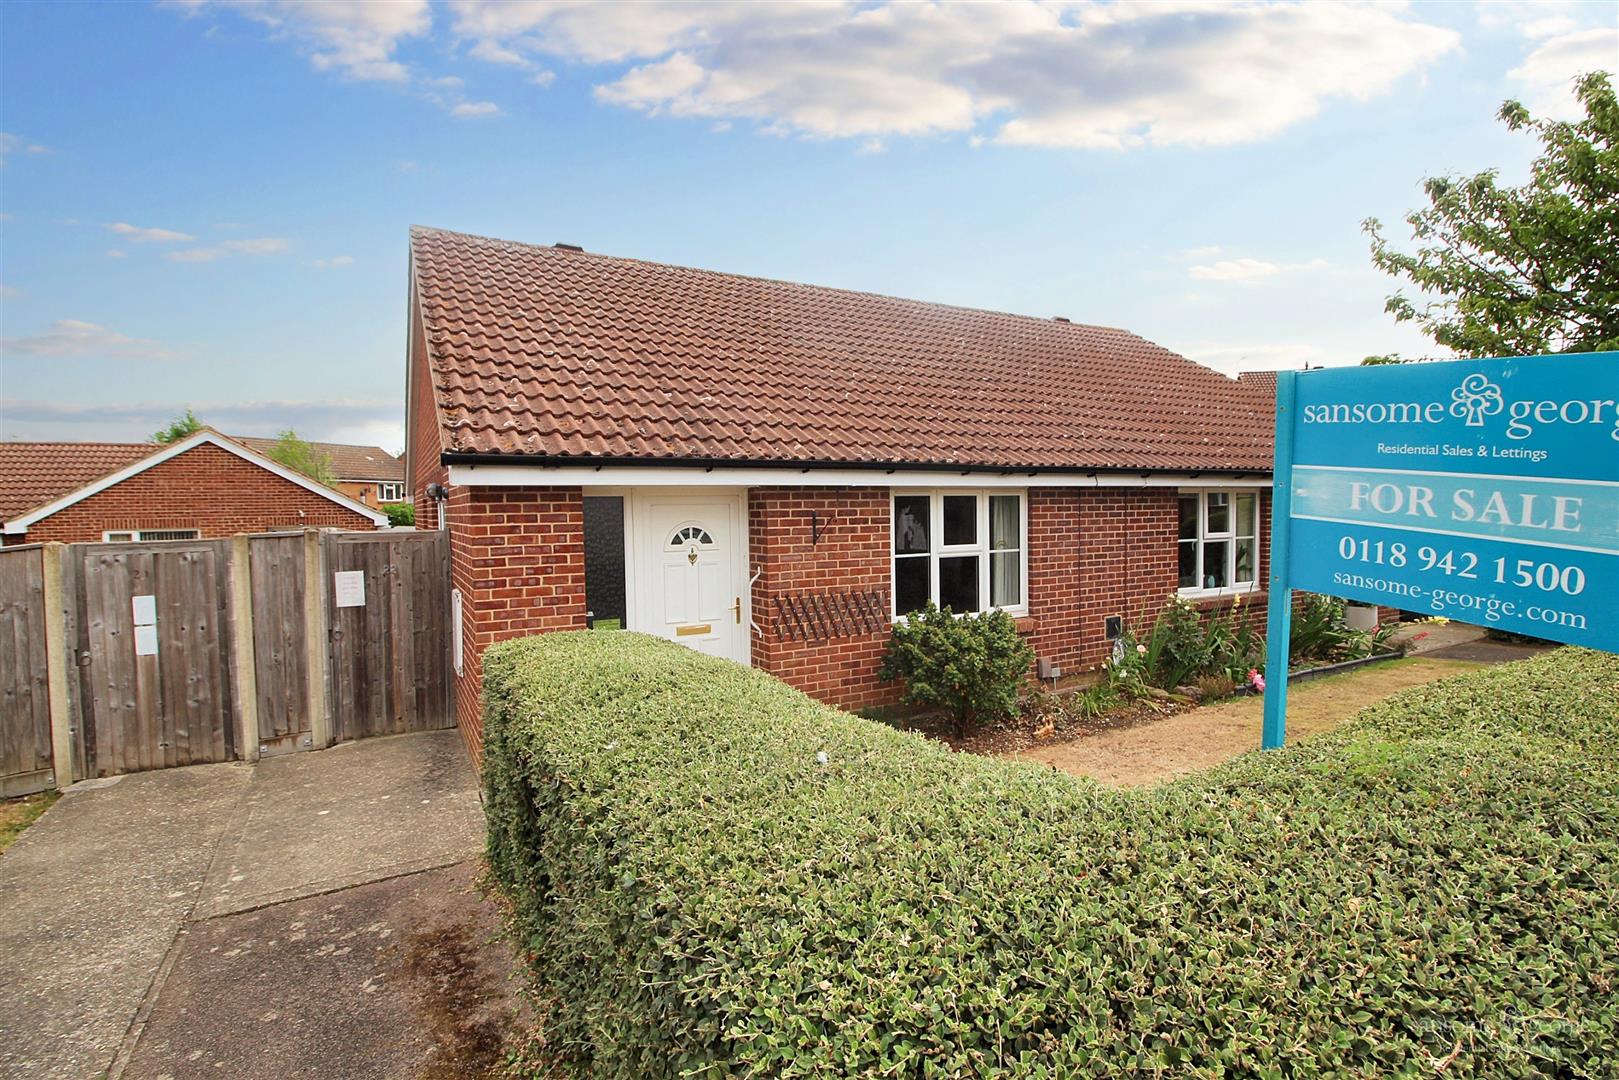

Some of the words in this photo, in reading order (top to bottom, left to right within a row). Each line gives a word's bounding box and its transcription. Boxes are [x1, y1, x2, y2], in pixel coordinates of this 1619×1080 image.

[1303, 402, 1444, 424] sansome
[1377, 443, 1439, 456] Residential
[1442, 444, 1473, 457] Sales
[1477, 445, 1488, 458] &
[1492, 446, 1548, 462] Lettings
[1350, 482, 1438, 518] FOR
[1452, 490, 1584, 532] SALE
[1338, 536, 1407, 568] 0118
[1417, 547, 1478, 579] 942
[1493, 557, 1586, 596] 1500
[1333, 571, 1588, 629] sansome-george.com
